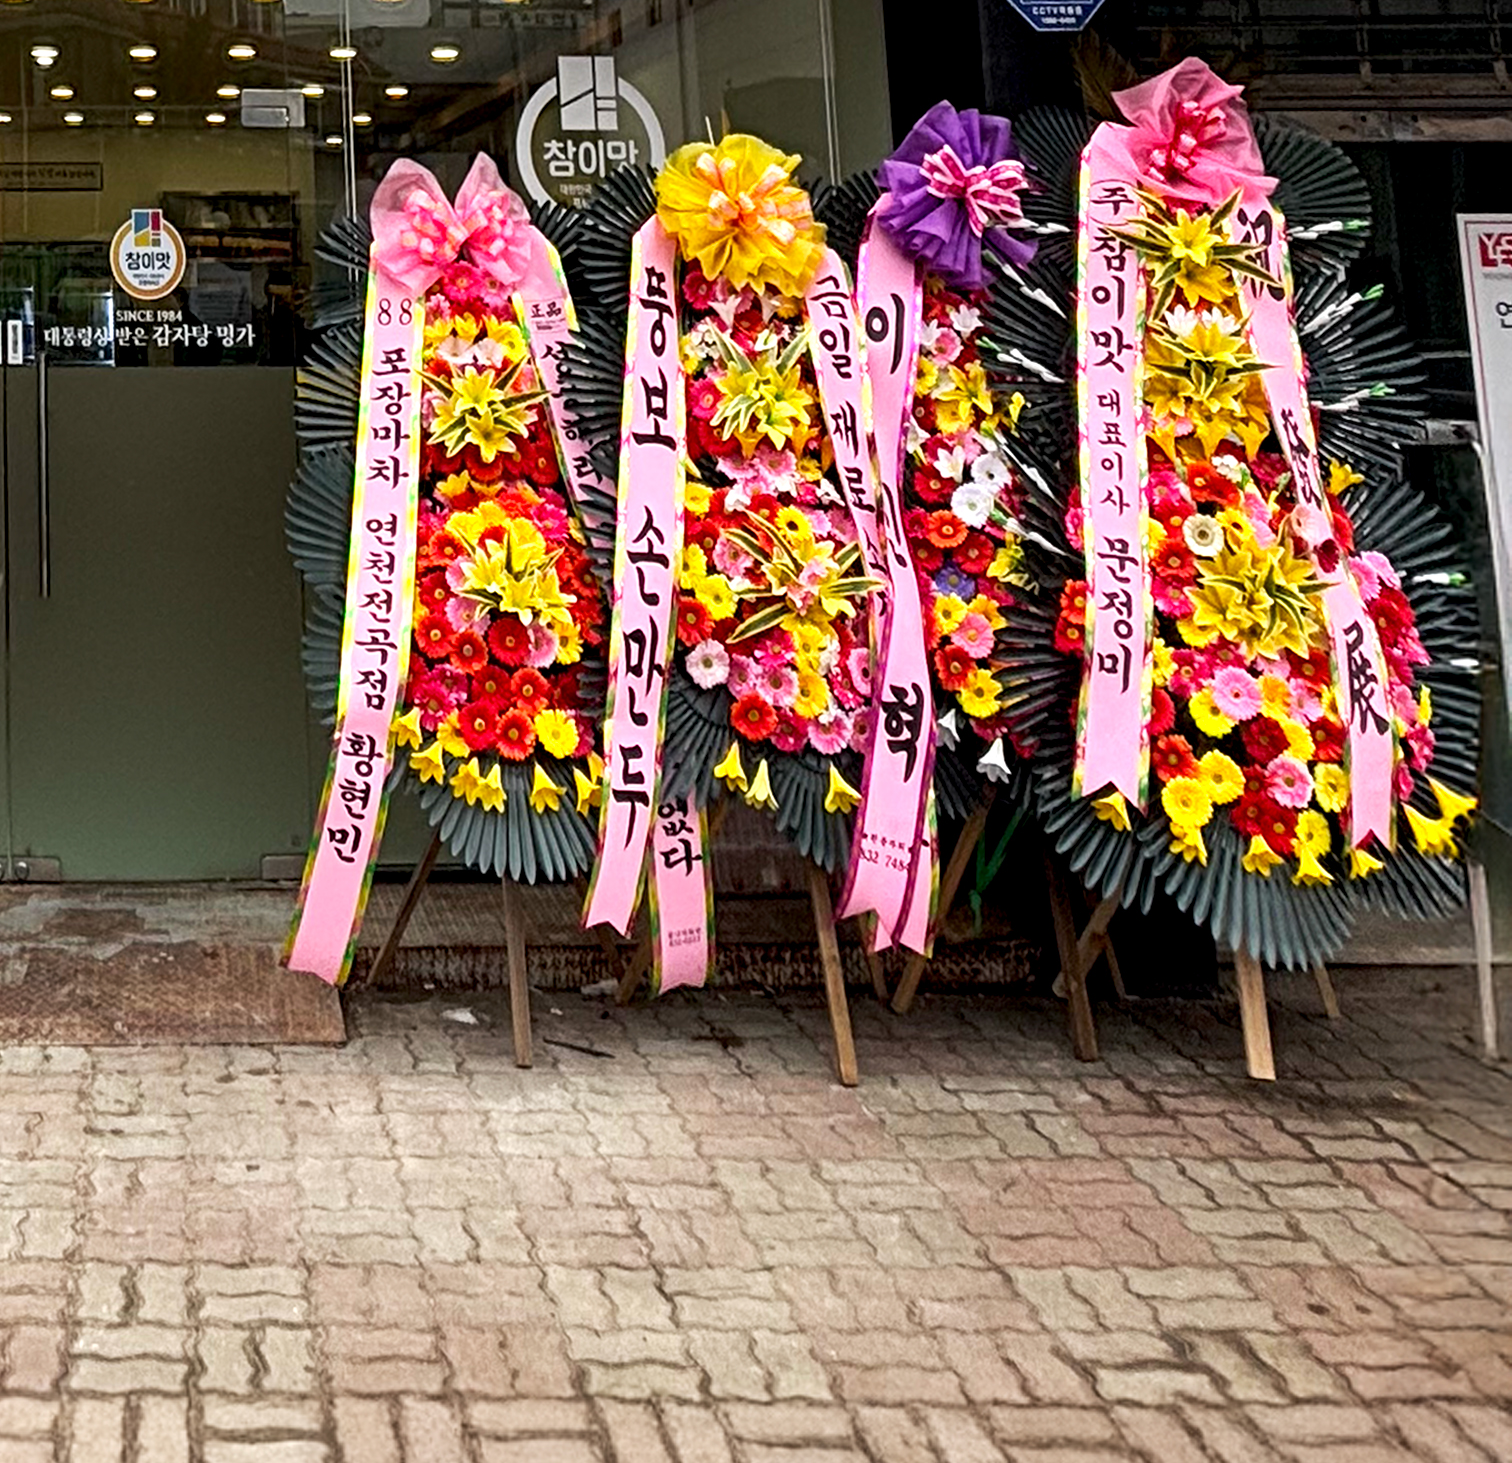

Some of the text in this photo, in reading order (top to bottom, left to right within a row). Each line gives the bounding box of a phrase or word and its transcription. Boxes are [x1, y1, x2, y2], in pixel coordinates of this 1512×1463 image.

[542, 138, 640, 179] 참이맛
[124, 251, 171, 272] 참이맛
[115, 309, 183, 323] SINCE 1984
[115, 325, 148, 348] 받은
[152, 323, 212, 348] 감자탕
[809, 275, 853, 380] 금일
[1097, 389, 1132, 516] 대표이사
[326, 298, 413, 864] 88 포장마차 연천전곡점 황현민
[1096, 535, 1139, 695] 문정미
[612, 505, 671, 851] 손만두
[656, 797, 703, 878] 없다
